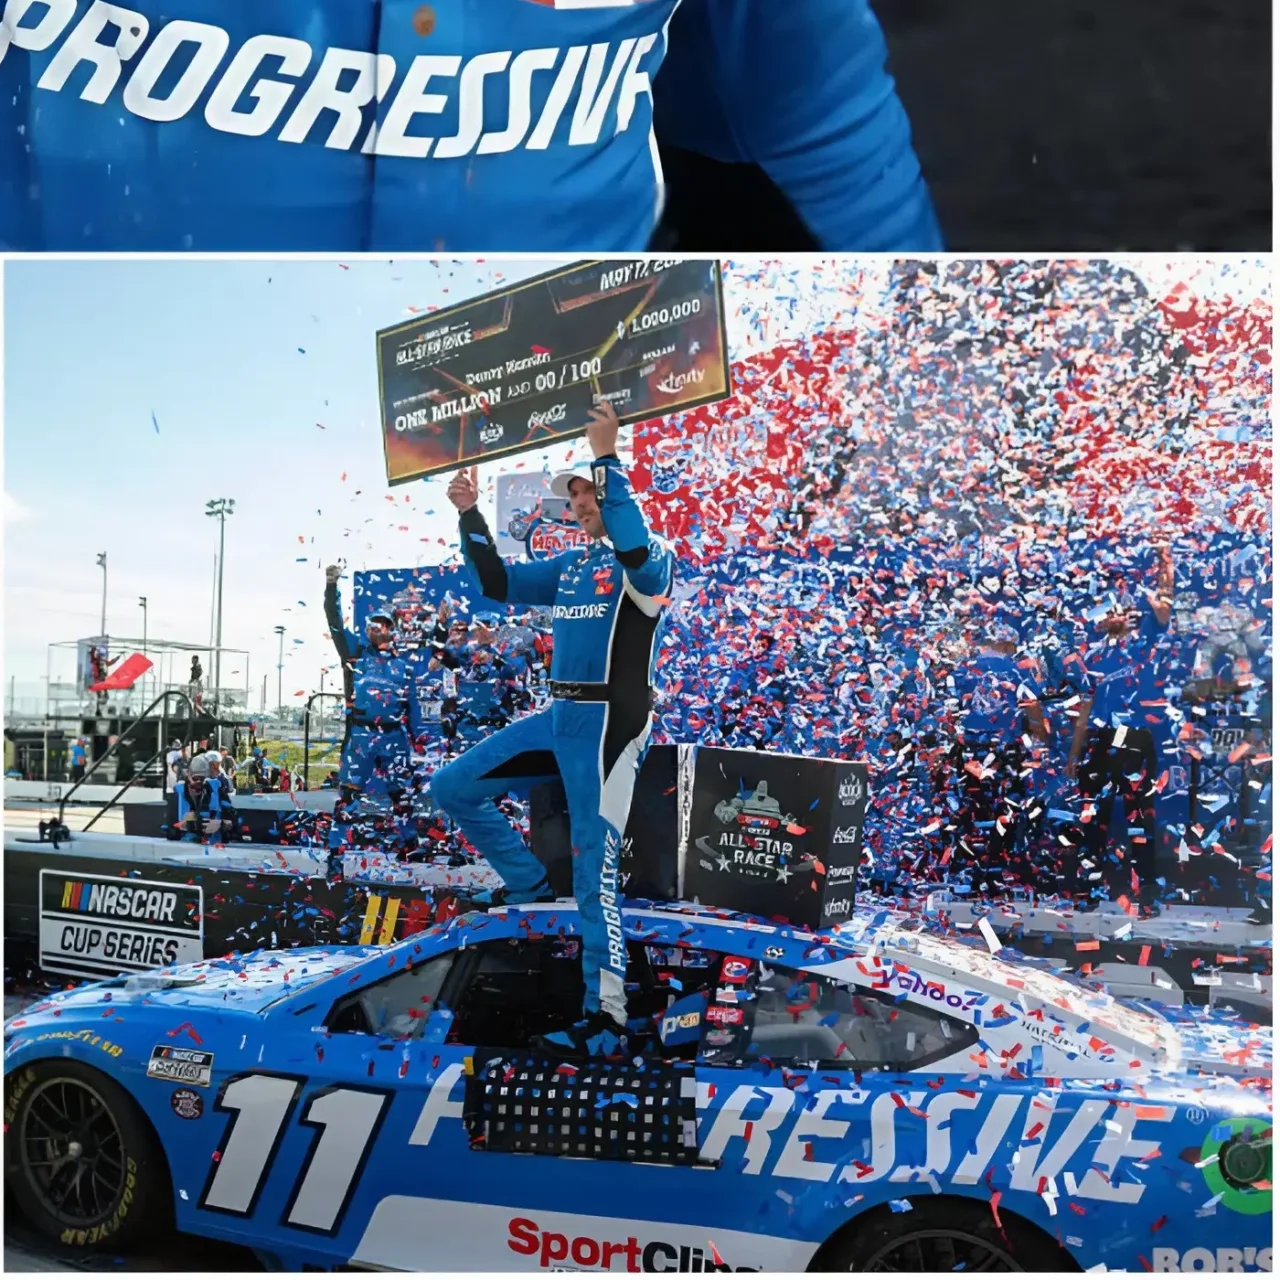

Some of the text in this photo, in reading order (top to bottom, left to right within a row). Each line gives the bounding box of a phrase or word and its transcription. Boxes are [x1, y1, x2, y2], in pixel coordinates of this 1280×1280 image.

[88, 883, 177, 922] NASCAR
[60, 925, 180, 967] CUP SERIES
[200, 1072, 390, 1235] 11
[507, 1217, 760, 1273] SportCli
